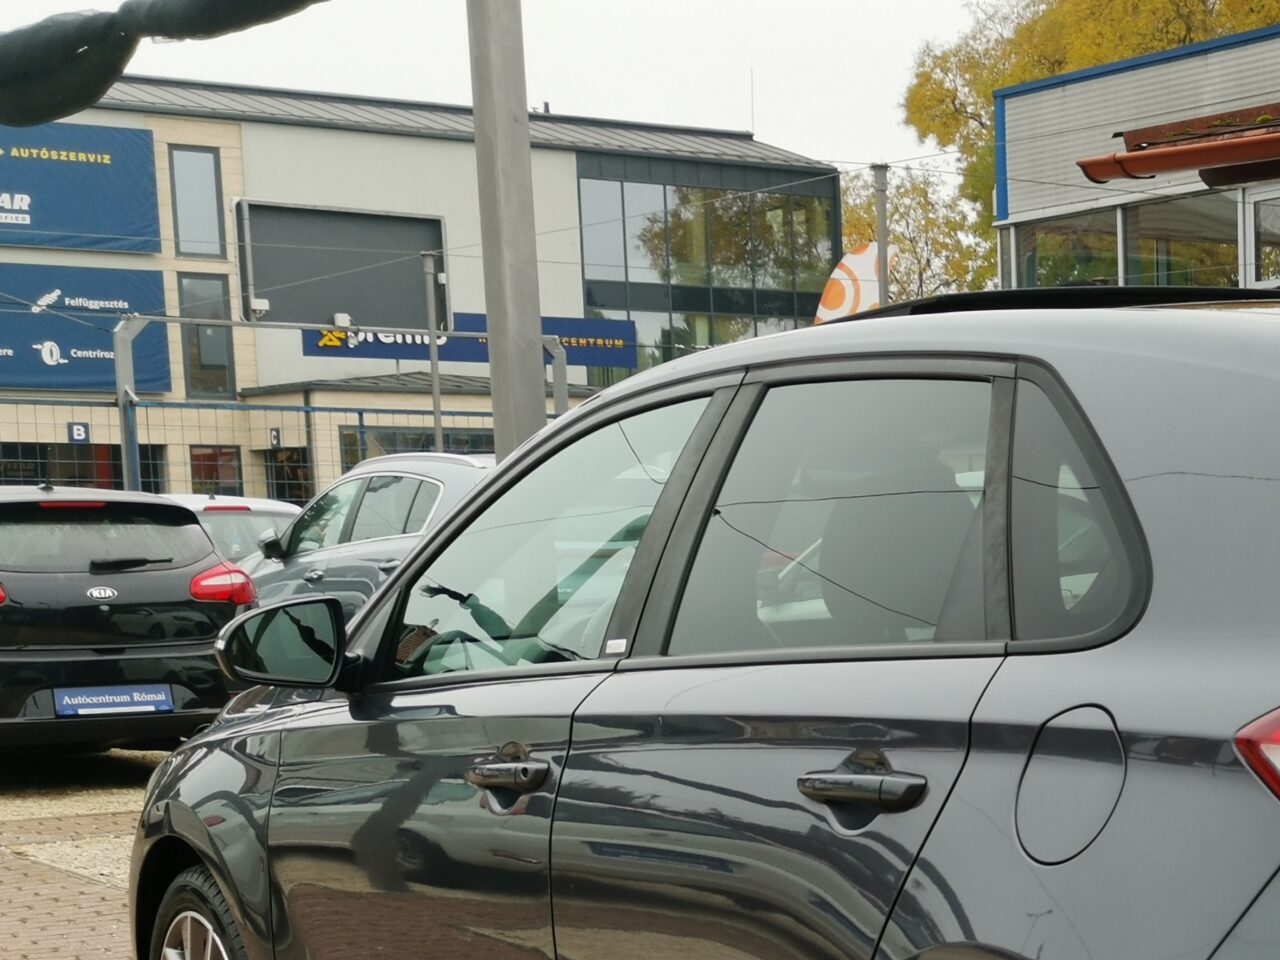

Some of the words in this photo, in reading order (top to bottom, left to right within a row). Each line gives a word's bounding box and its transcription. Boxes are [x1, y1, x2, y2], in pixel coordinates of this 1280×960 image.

[10, 147, 112, 164] AUTÓSZERVIZ
[64, 297, 129, 310] Felfüggesztés
[73, 425, 86, 440] B
[271, 430, 278, 445] C
[62, 693, 131, 705] Autócentrum
[133, 691, 166, 701] Római
